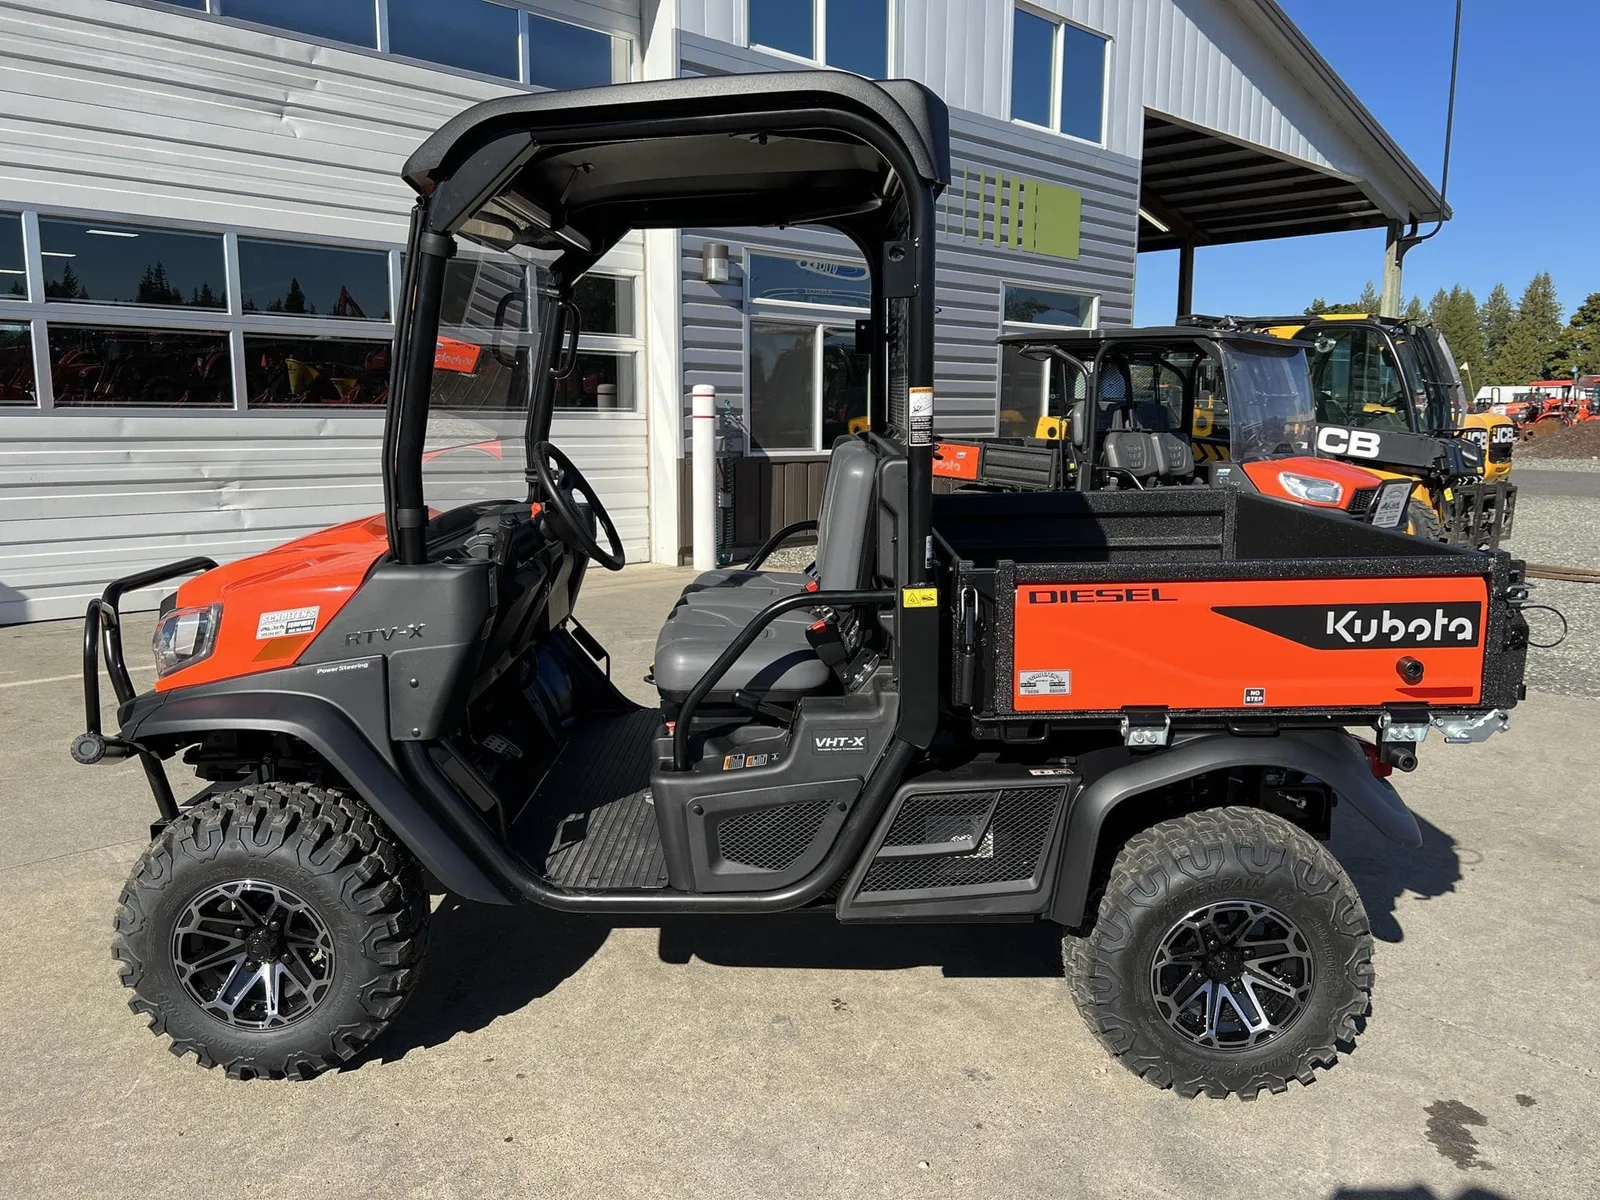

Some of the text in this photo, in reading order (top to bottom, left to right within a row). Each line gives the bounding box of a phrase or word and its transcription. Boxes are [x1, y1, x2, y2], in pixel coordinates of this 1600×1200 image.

[1492, 427, 1514, 443] JCB
[1029, 588, 1178, 604] DIESEL
[1326, 608, 1473, 643] Kubota
[345, 623, 426, 646] RTV-X
[339, 662, 369, 671] Steering
[815, 736, 865, 747] VHT-X
